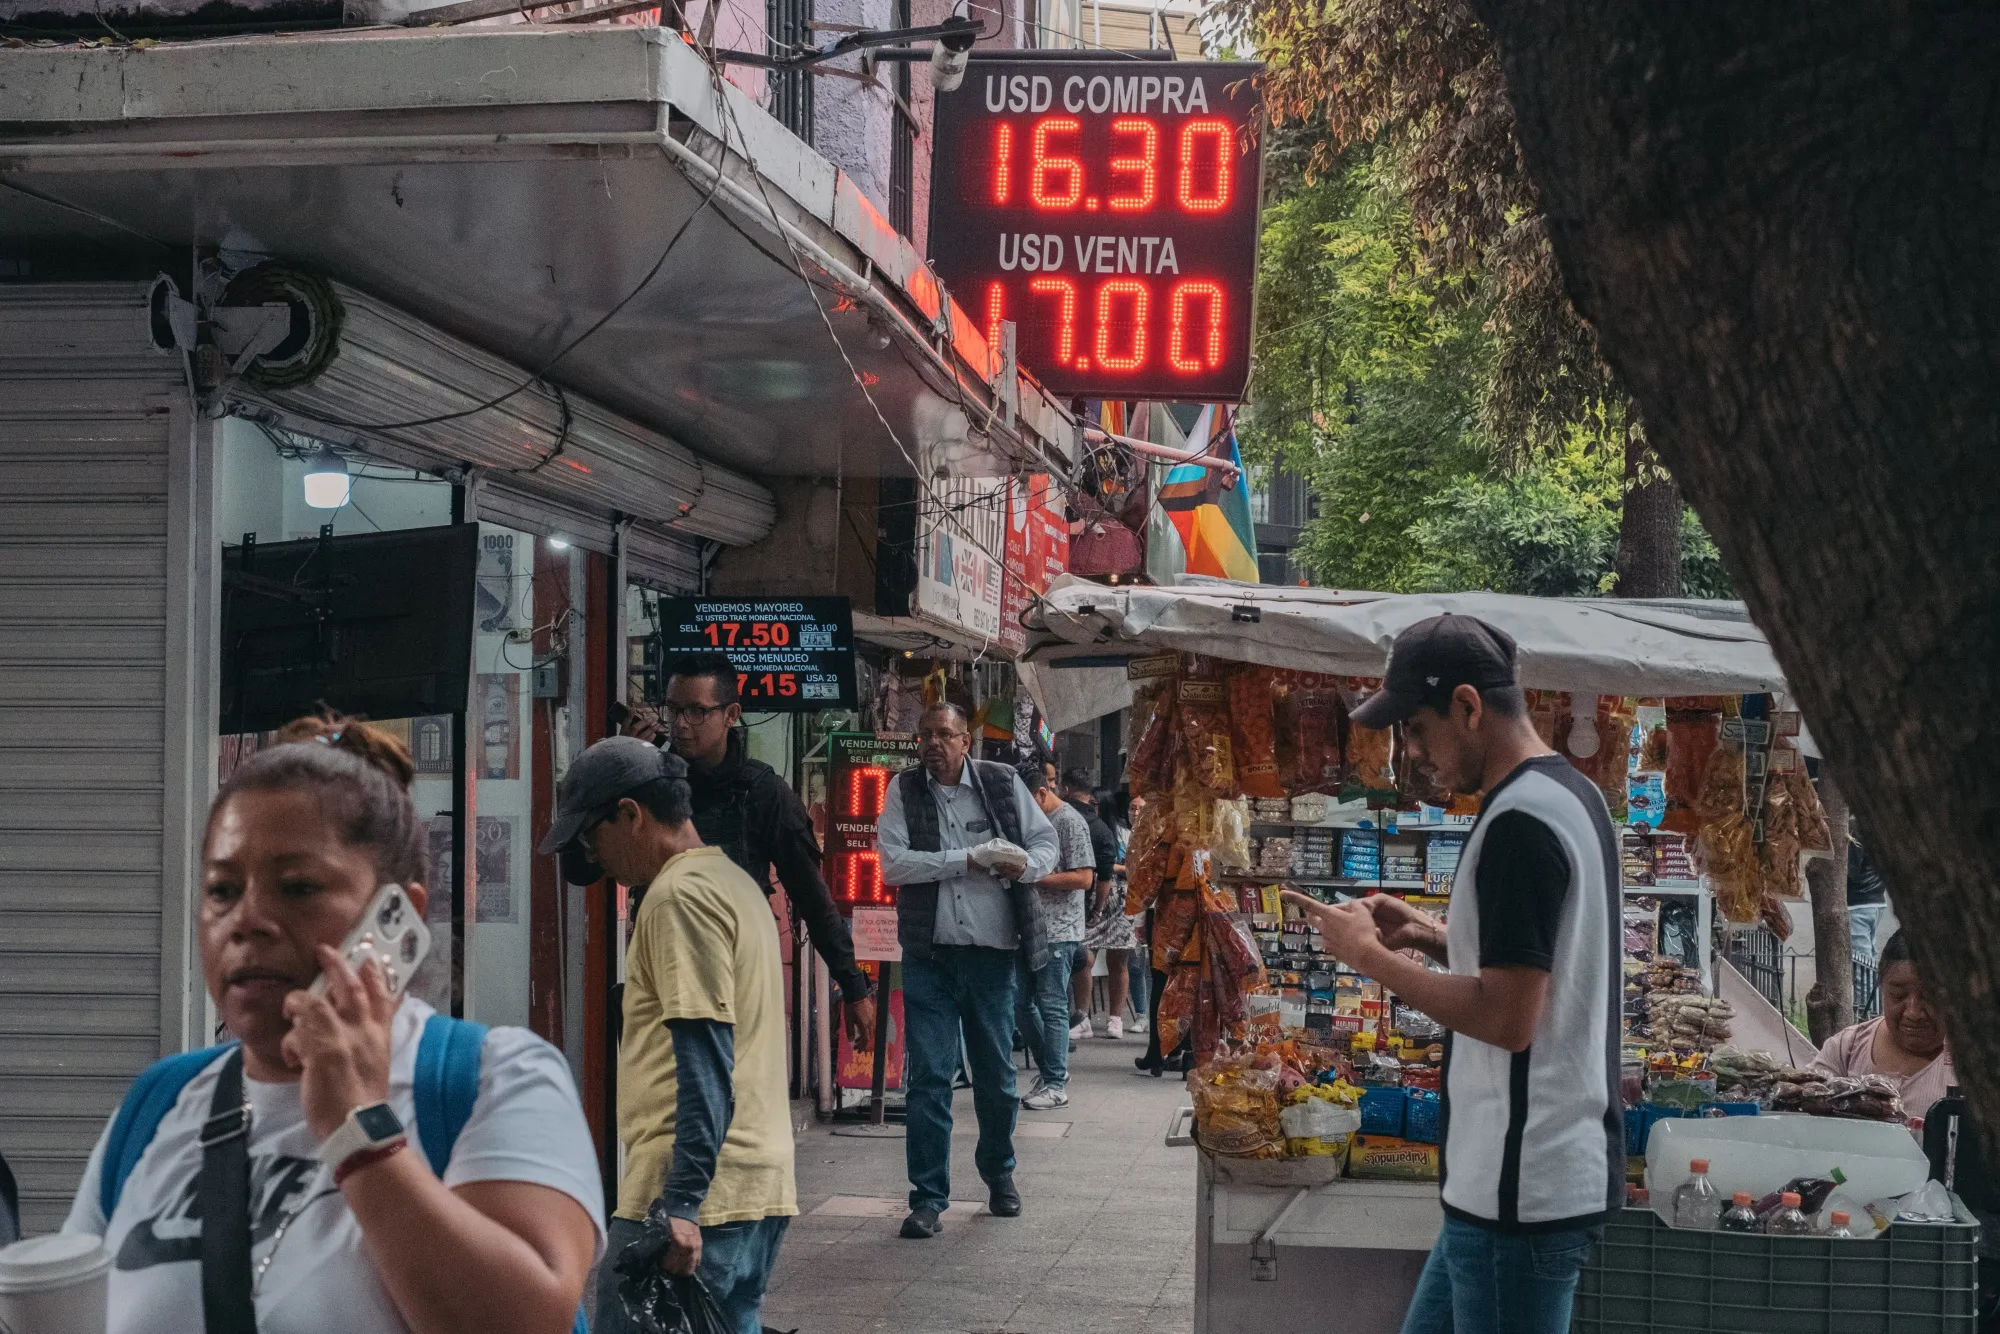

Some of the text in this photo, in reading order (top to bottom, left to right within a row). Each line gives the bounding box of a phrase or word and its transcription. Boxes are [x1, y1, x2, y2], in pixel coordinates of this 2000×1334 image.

[985, 76, 1209, 114] USD COMPRA
[994, 119, 1232, 211] 16.30
[999, 233, 1179, 274] USD VENTA
[988, 280, 1222, 371] 17.00
[483, 534, 513, 549] 1000
[694, 603, 803, 612] VENDEMOS MAYOREO
[679, 624, 700, 632] SELL
[704, 623, 790, 646] 17.50
[822, 624, 838, 632] 100
[759, 654, 809, 662] MENUDEO
[806, 674, 825, 682] USA
[826, 674, 838, 682] 20
[839, 739, 896, 749] VENDEMOS
[850, 755, 872, 764] SELL
[846, 839, 868, 847] SELL
[1364, 1150, 1430, 1167] Pulparindots
